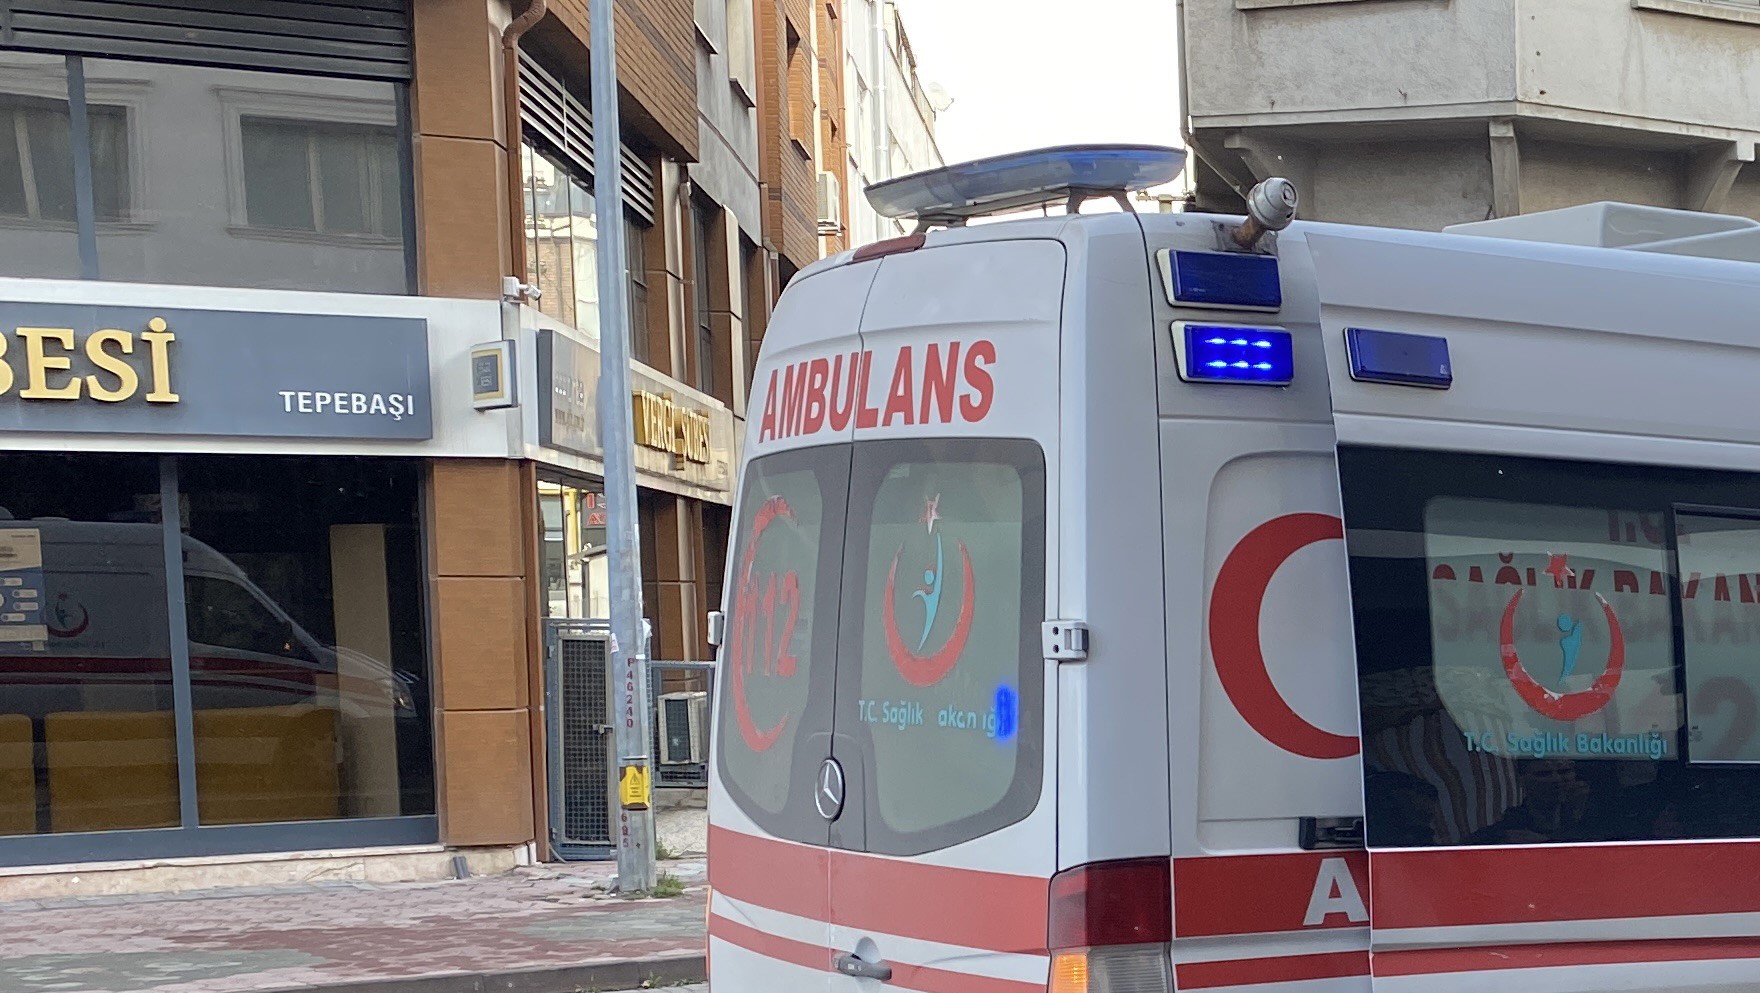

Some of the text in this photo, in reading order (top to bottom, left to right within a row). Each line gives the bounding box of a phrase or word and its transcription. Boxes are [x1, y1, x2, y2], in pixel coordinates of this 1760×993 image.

[0, 316, 179, 402] ESİ
[279, 391, 414, 421] TEPEBAŞI
[759, 339, 996, 443] AMBULANS
[882, 700, 923, 731] Sağlık
[1507, 730, 1569, 758] Sağlık
[1576, 732, 1669, 760] Bakanlığı
[1303, 857, 1369, 926] A
